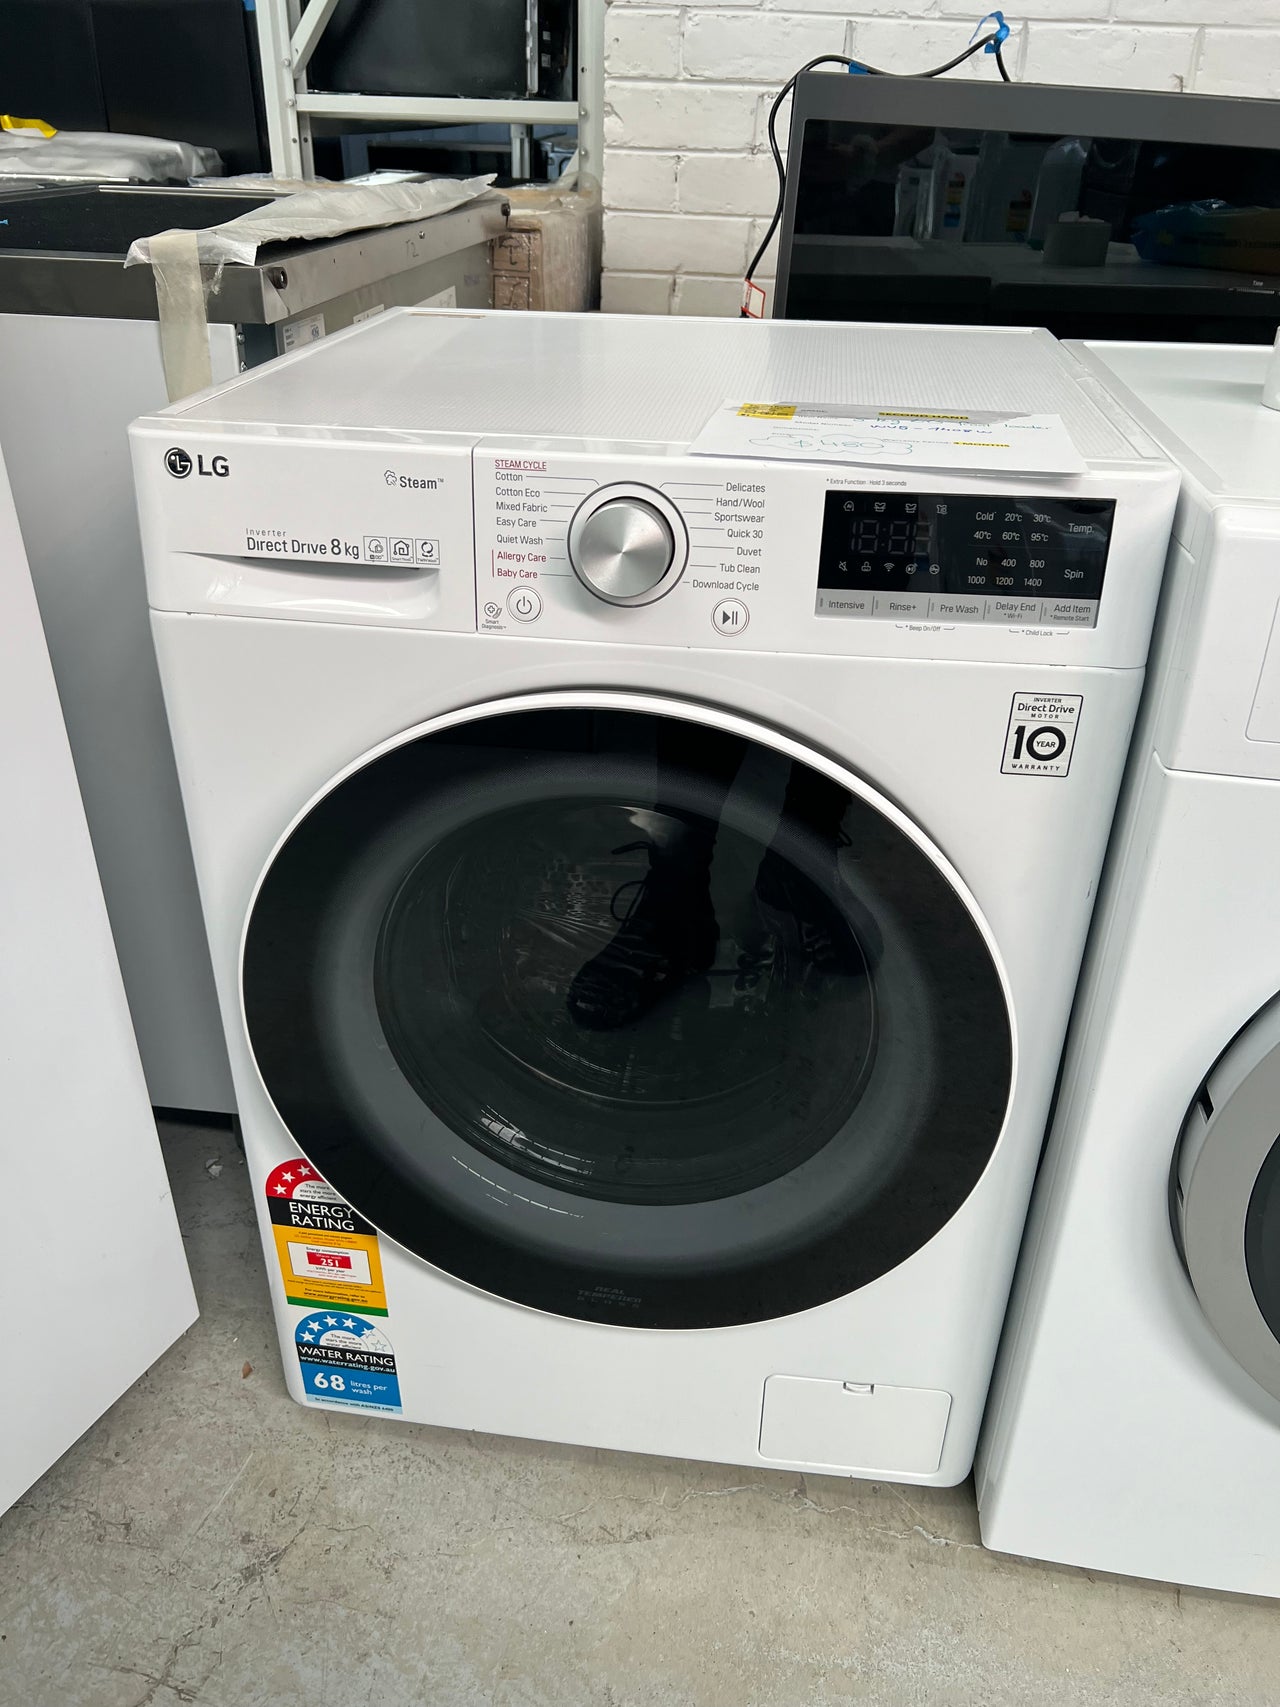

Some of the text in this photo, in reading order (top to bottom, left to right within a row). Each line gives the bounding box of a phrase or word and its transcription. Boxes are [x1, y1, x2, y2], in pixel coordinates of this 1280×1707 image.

[197, 454, 230, 478] LG
[495, 460, 547, 470] STEAM CYCLE
[495, 472, 523, 482] Cotton
[845, 478, 866, 486] Function
[495, 487, 541, 498] Cotton Eco
[726, 482, 766, 493] Delicates
[496, 502, 548, 513] Mixed Fabric
[716, 498, 765, 509] Hand/Wool
[714, 512, 765, 524] Sportswear
[975, 511, 994, 522] Cold
[496, 518, 537, 529] Easy Care
[1068, 523, 1095, 535] Temp.
[245, 528, 287, 537] Inverter
[727, 528, 763, 539] Quick 30
[496, 534, 543, 545] Quiet Wash
[246, 537, 359, 560] Direct Drive 8 kg
[736, 547, 762, 557] Duvet
[497, 551, 547, 563] Allergy Care
[976, 557, 1044, 568] No 400 800
[497, 568, 538, 579] Baby Care
[720, 563, 761, 574] Tub Clean
[1064, 569, 1084, 580] Spin
[692, 579, 760, 592] Download Cycle
[968, 575, 1042, 587] 1000 1200 1400
[828, 600, 865, 610] Intensive
[889, 602, 917, 612] Rinse+
[940, 604, 979, 614] Pre Wash
[995, 602, 1036, 613] Delay End
[1054, 604, 1091, 614] Add Item
[909, 624, 923, 632] Beep
[1017, 703, 1075, 714] Direct Drive
[1013, 725, 1066, 761] 10
[1036, 740, 1056, 748] YEAR
[1012, 763, 1061, 771] WARRANTY
[289, 1202, 354, 1219] ENERGY
[291, 1214, 355, 1232] RATING
[320, 1258, 339, 1268] 251
[298, 1345, 394, 1366] WATER RATING
[300, 1356, 396, 1373] www.waterrating.gov.au
[314, 1372, 346, 1391] 68
[350, 1380, 388, 1391] litres per
